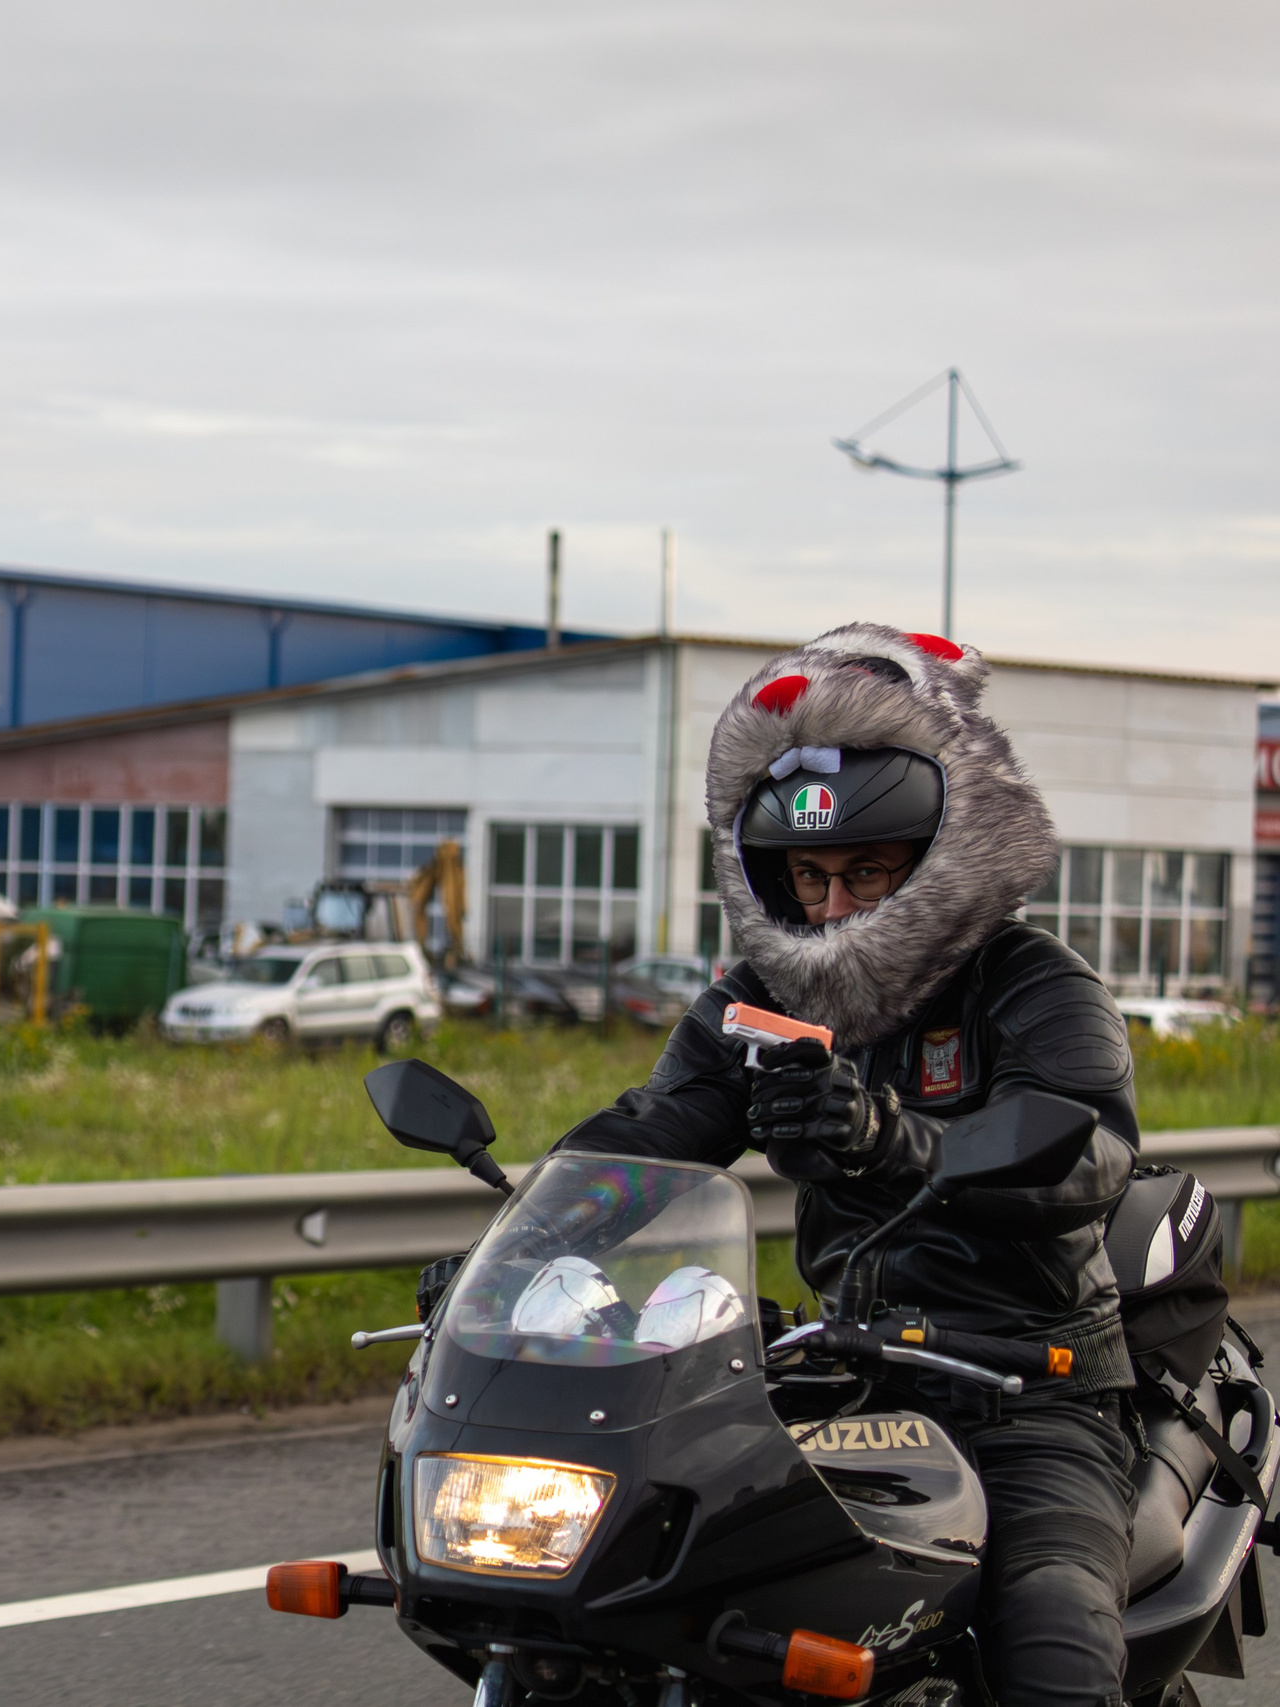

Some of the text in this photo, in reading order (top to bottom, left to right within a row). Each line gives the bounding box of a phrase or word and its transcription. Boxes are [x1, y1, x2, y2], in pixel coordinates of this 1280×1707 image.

[796, 811, 830, 829] agv
[788, 1420, 929, 1451] SUZUKI
[913, 1610, 945, 1634] 600
